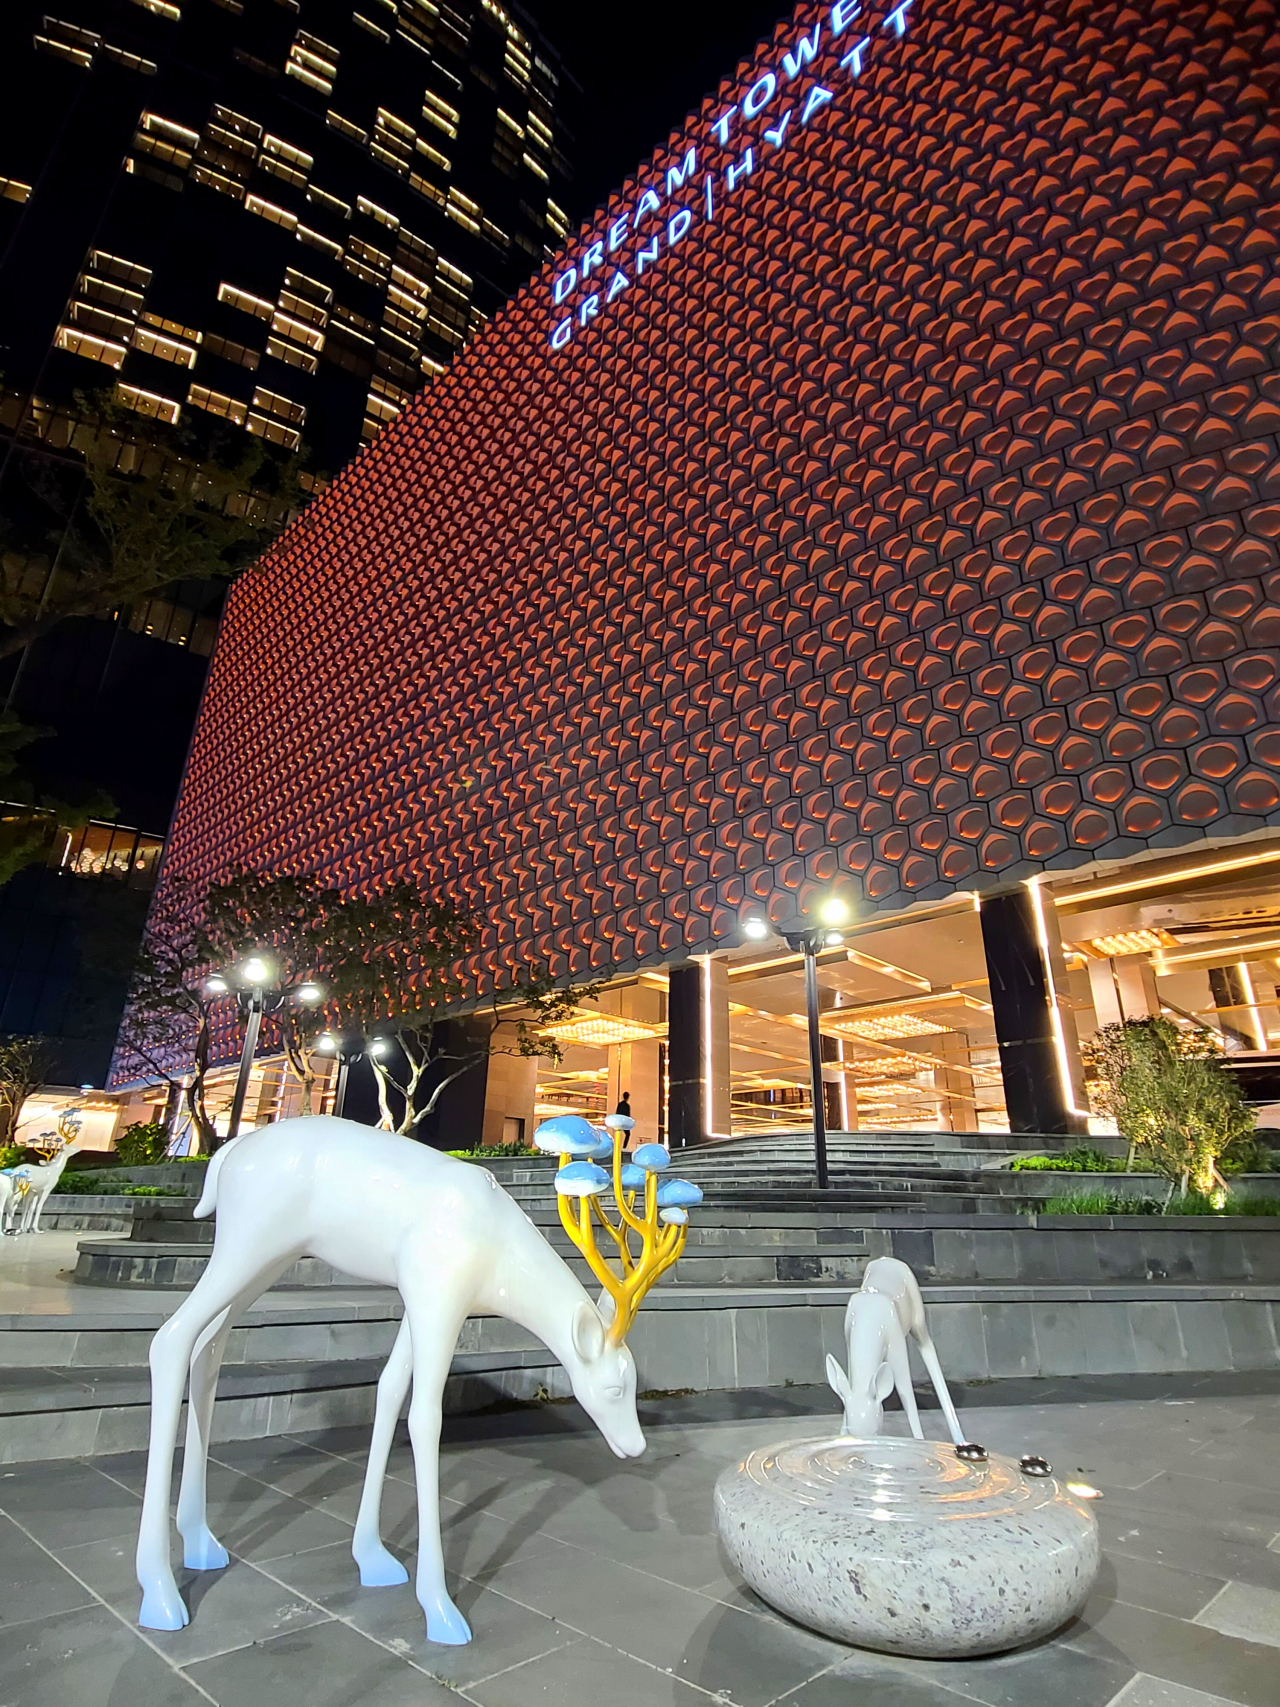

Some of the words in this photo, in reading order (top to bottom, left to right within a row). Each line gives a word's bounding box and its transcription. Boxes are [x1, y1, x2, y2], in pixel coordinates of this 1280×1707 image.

[550, 208, 693, 350] GRAND
[727, 0, 914, 192] HYATT
[553, 146, 697, 306] DREAM
